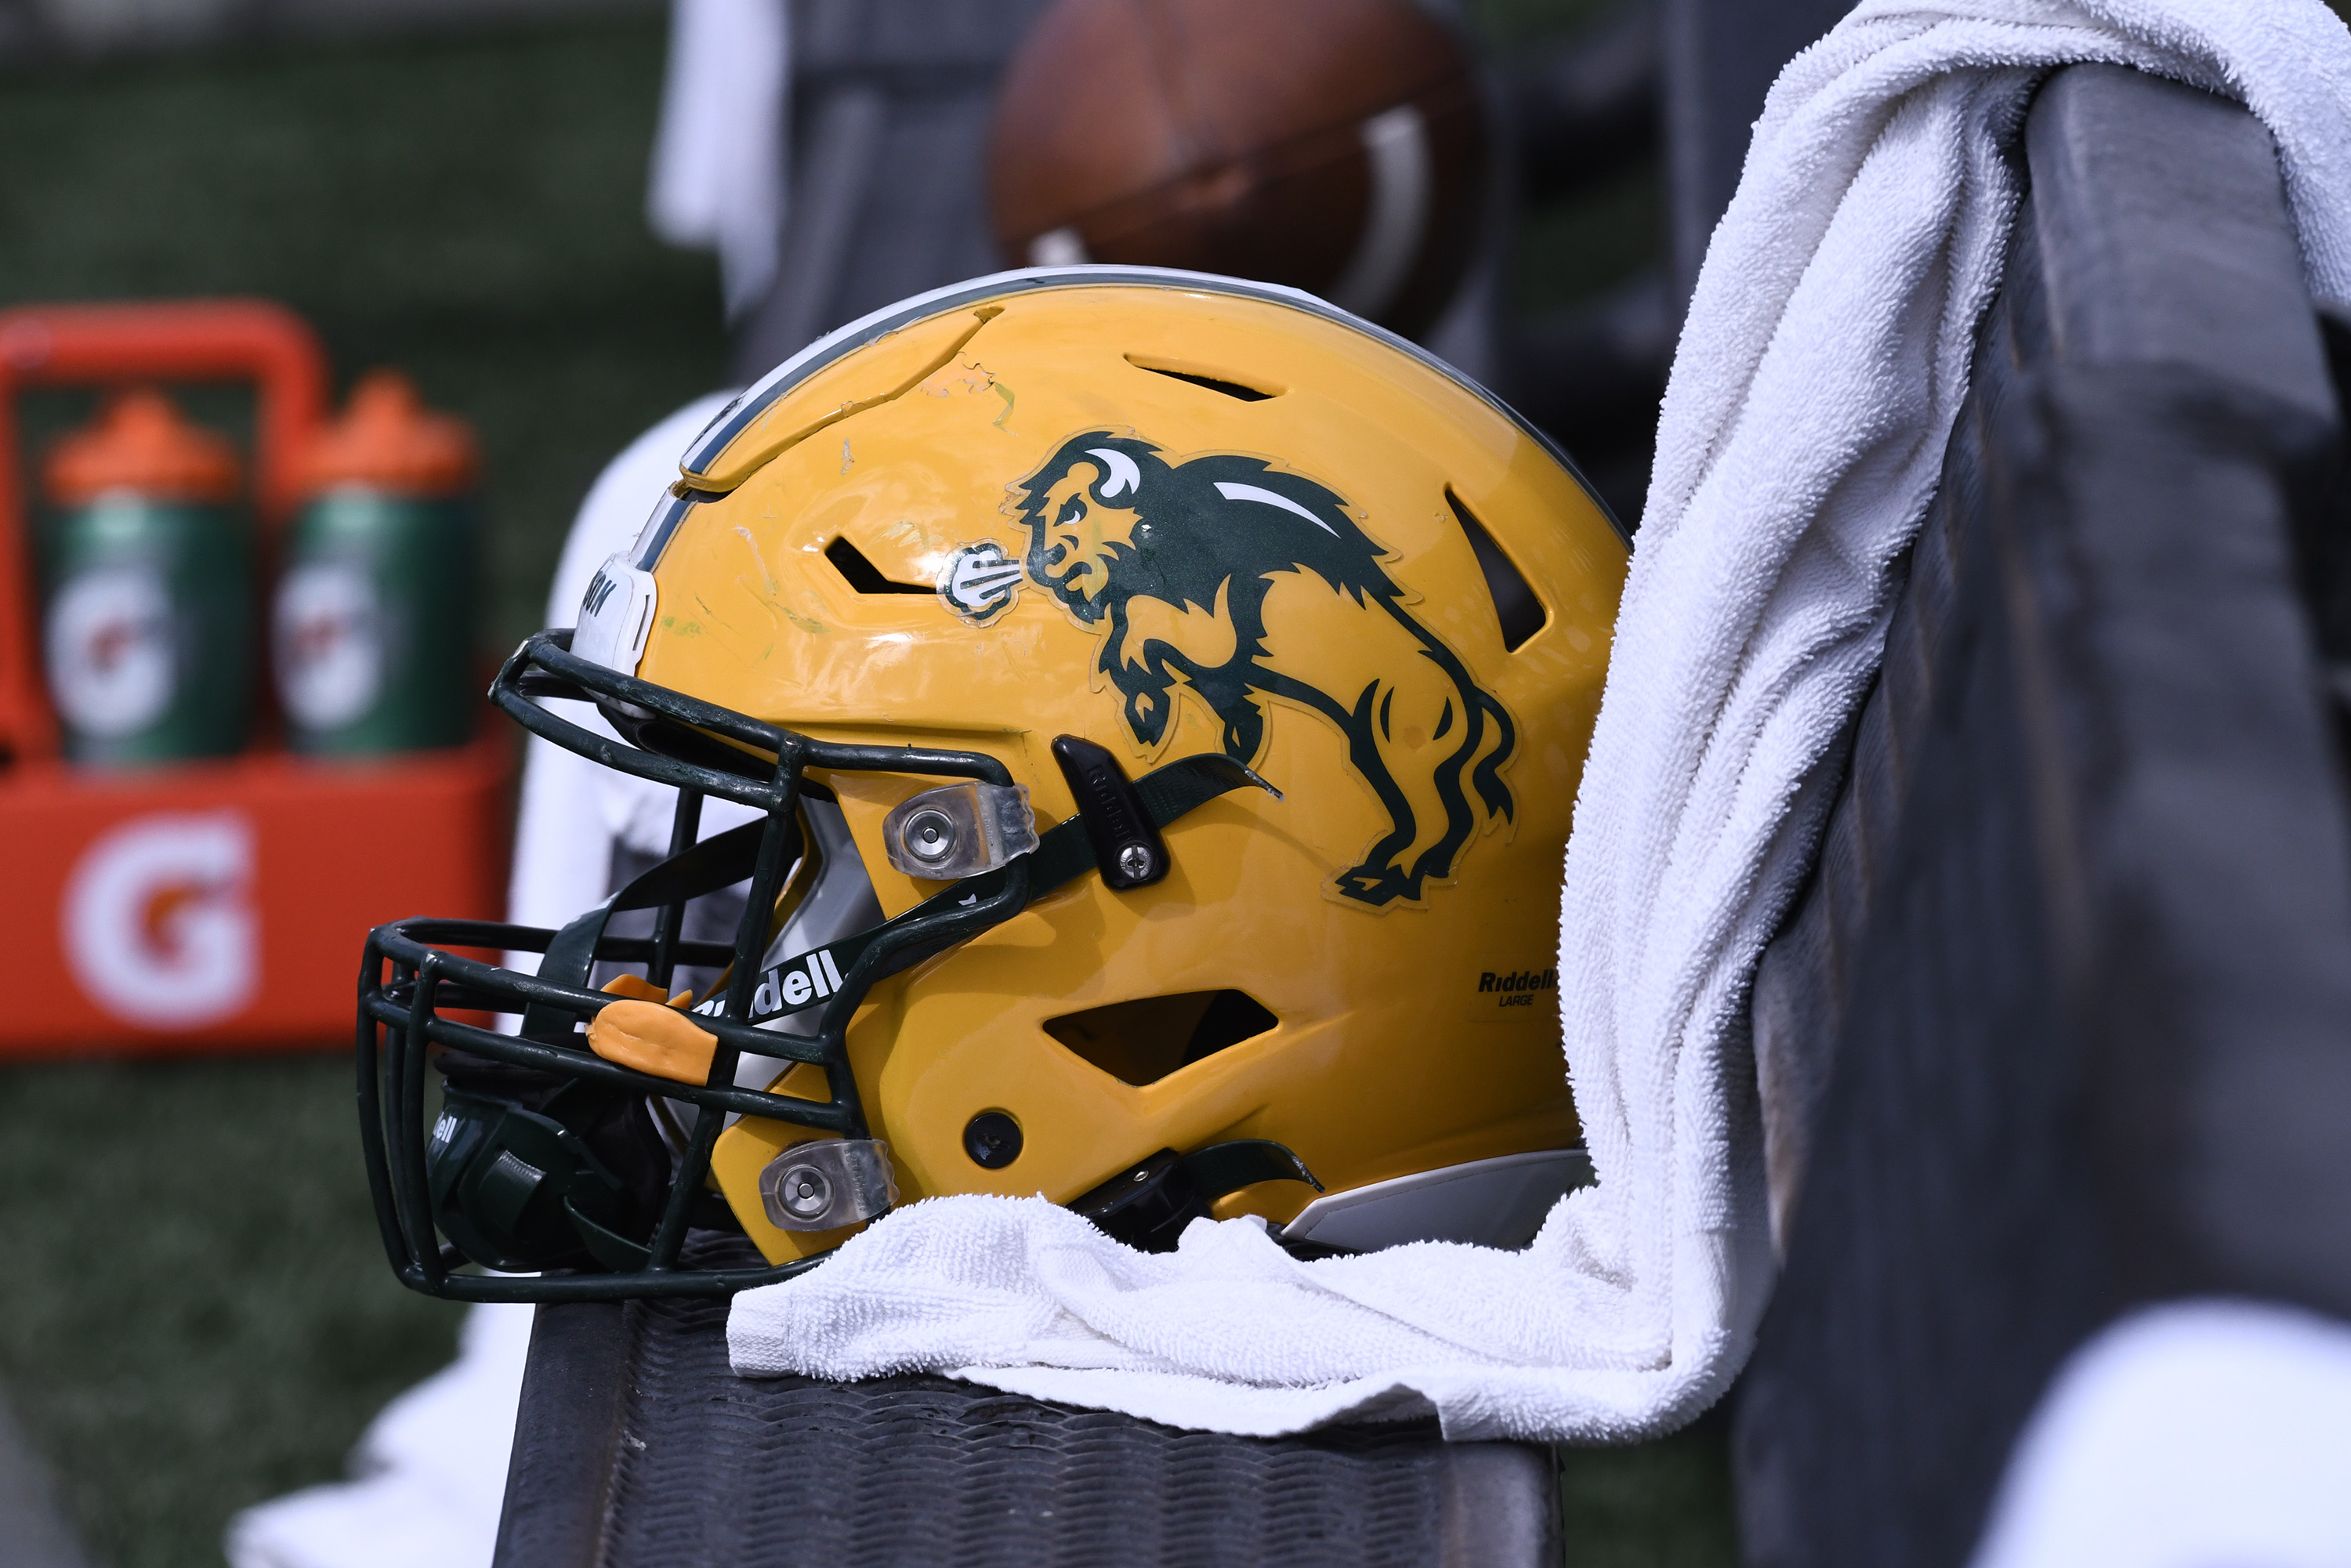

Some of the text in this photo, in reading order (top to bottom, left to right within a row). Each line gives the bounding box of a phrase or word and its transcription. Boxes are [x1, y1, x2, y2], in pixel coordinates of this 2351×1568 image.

[63, 812, 262, 1030] G
[691, 949, 844, 1019] dell
[1478, 969, 1555, 993] Riddell
[1498, 994, 1534, 1008] LARGE
